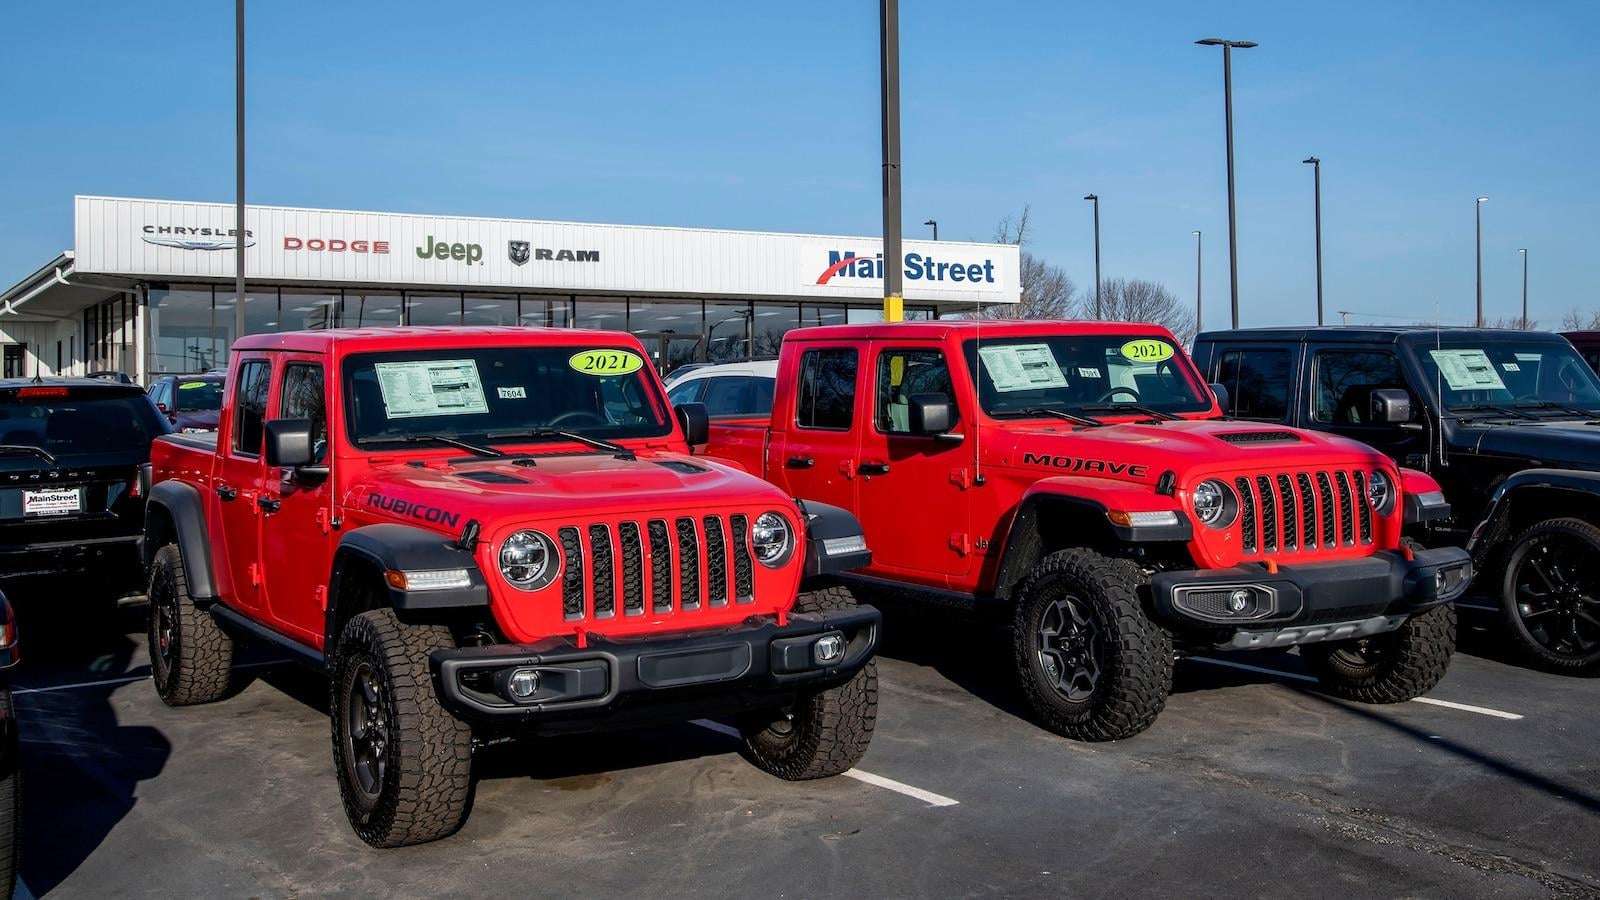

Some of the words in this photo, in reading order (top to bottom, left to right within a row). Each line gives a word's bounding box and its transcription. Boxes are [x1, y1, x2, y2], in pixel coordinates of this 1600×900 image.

[143, 225, 253, 237] CHRYSLER
[284, 237, 389, 254] DODGE
[416, 235, 483, 266] Jeep
[535, 248, 600, 262] RAM
[828, 250, 994, 283] MaiStreet
[1132, 343, 1164, 358] 2021
[585, 354, 628, 370] 2021
[1024, 453, 1147, 477] MOJAVE
[368, 493, 460, 527] RUBICON
